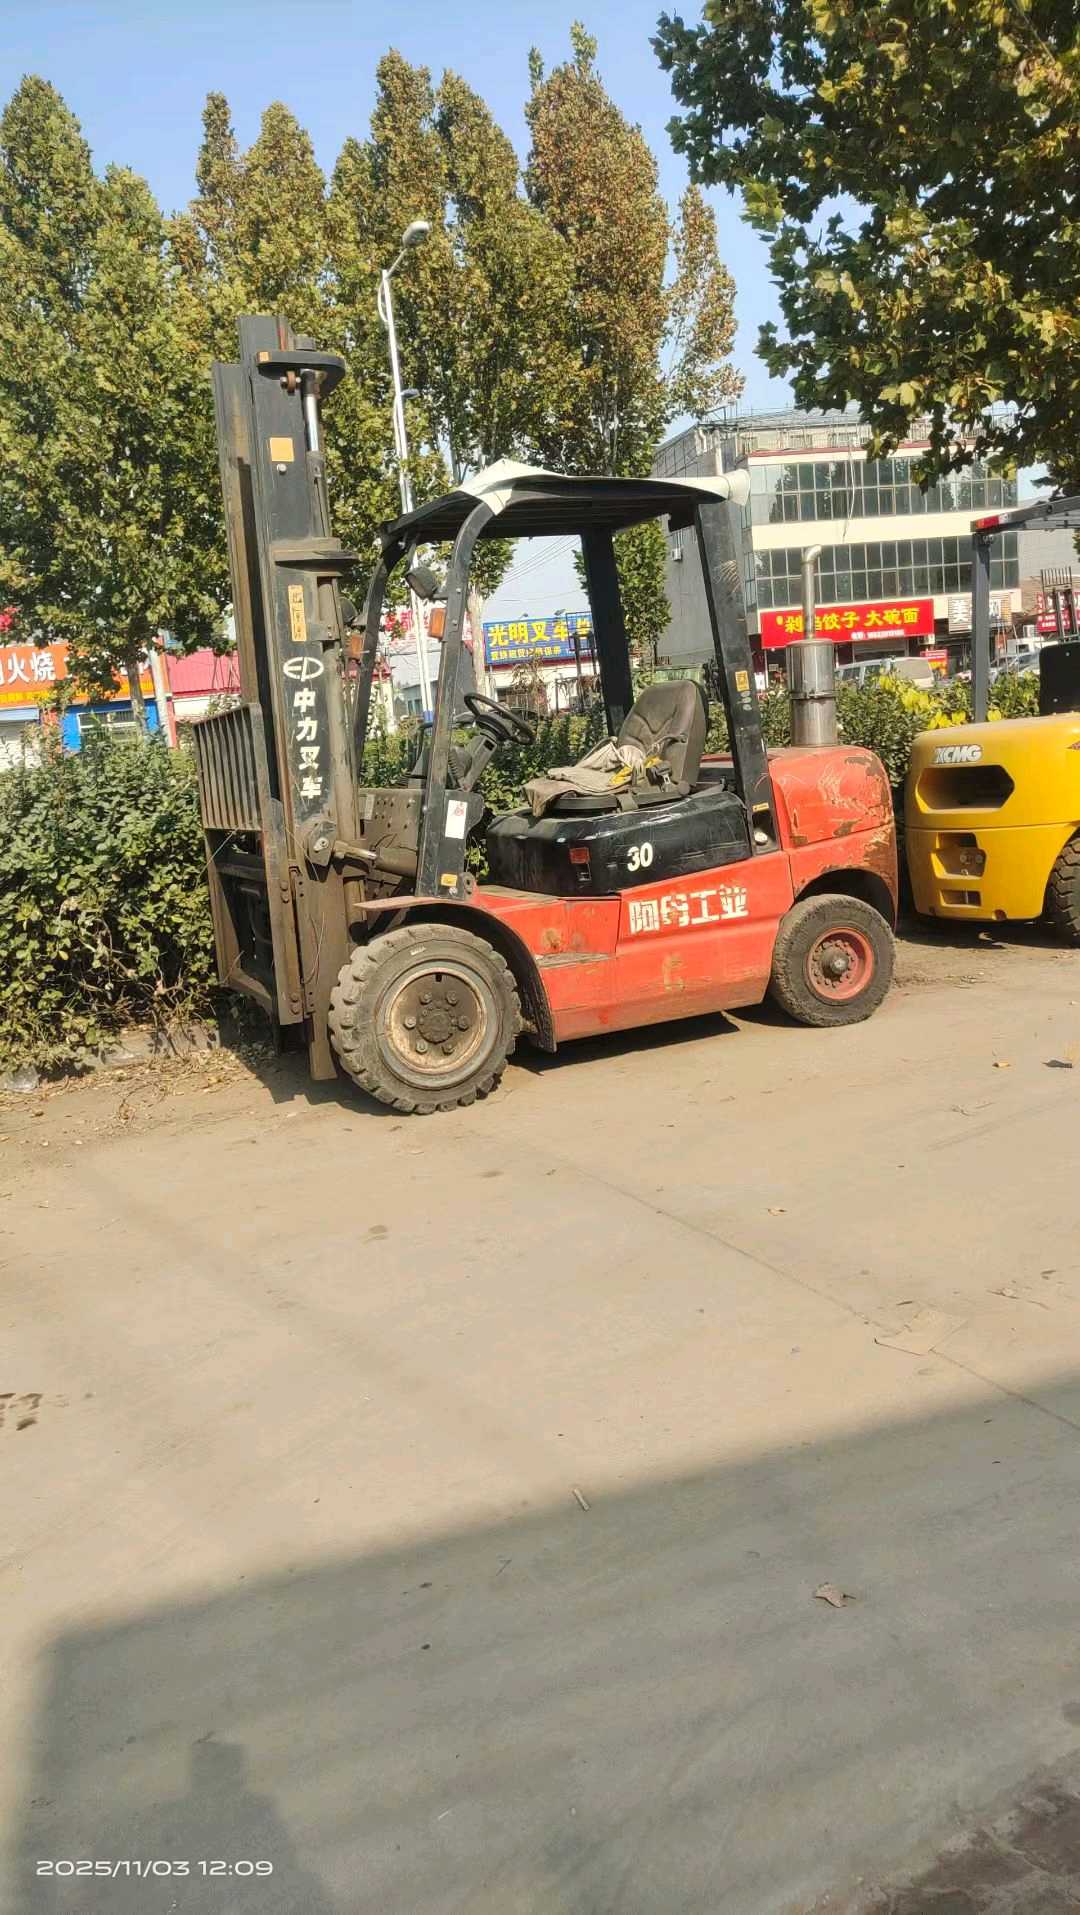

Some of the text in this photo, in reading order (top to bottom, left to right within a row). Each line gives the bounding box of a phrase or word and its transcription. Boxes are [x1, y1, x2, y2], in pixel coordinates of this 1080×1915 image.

[865, 607, 921, 627] 大碗面
[0, 651, 56, 685] 火烧
[293, 687, 323, 800] 中力叉车
[933, 743, 983, 764] XCMG
[626, 841, 654, 872] 30
